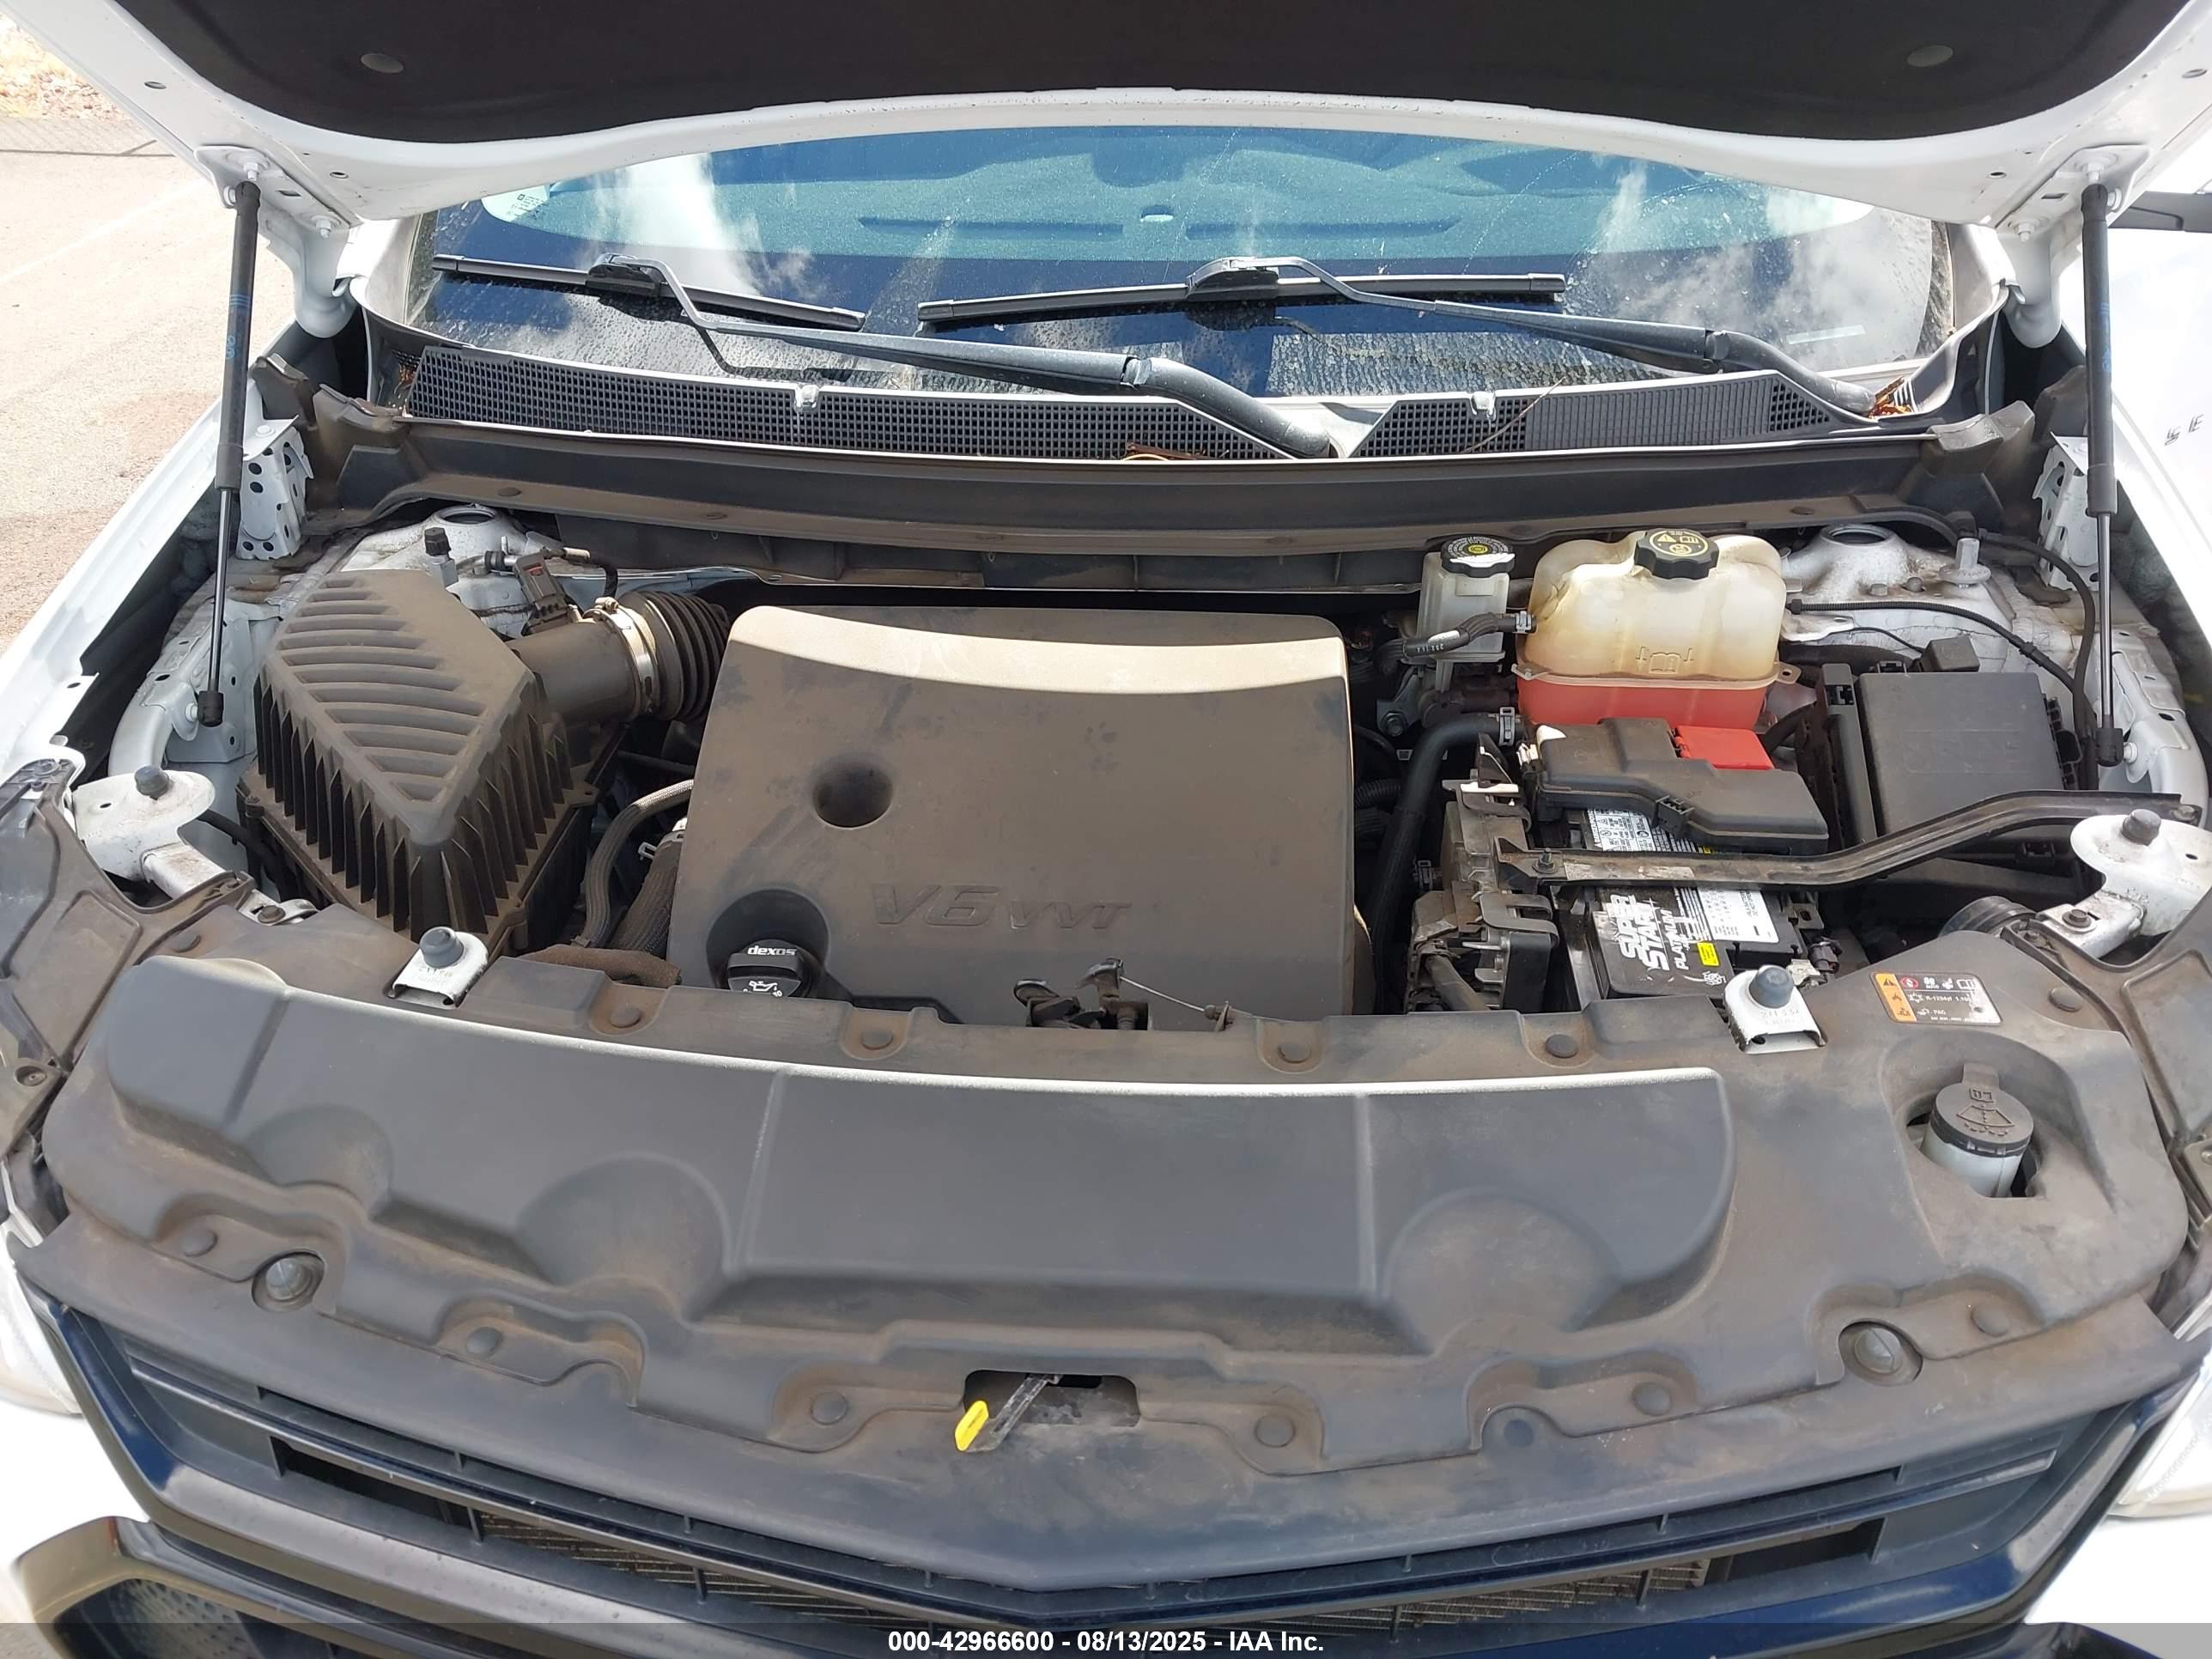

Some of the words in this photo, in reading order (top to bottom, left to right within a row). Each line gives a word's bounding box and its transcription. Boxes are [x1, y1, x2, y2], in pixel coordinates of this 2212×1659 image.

[871, 884, 1000, 927] V6
[1010, 900, 1132, 930] VVT
[747, 945, 798, 956] dexos
